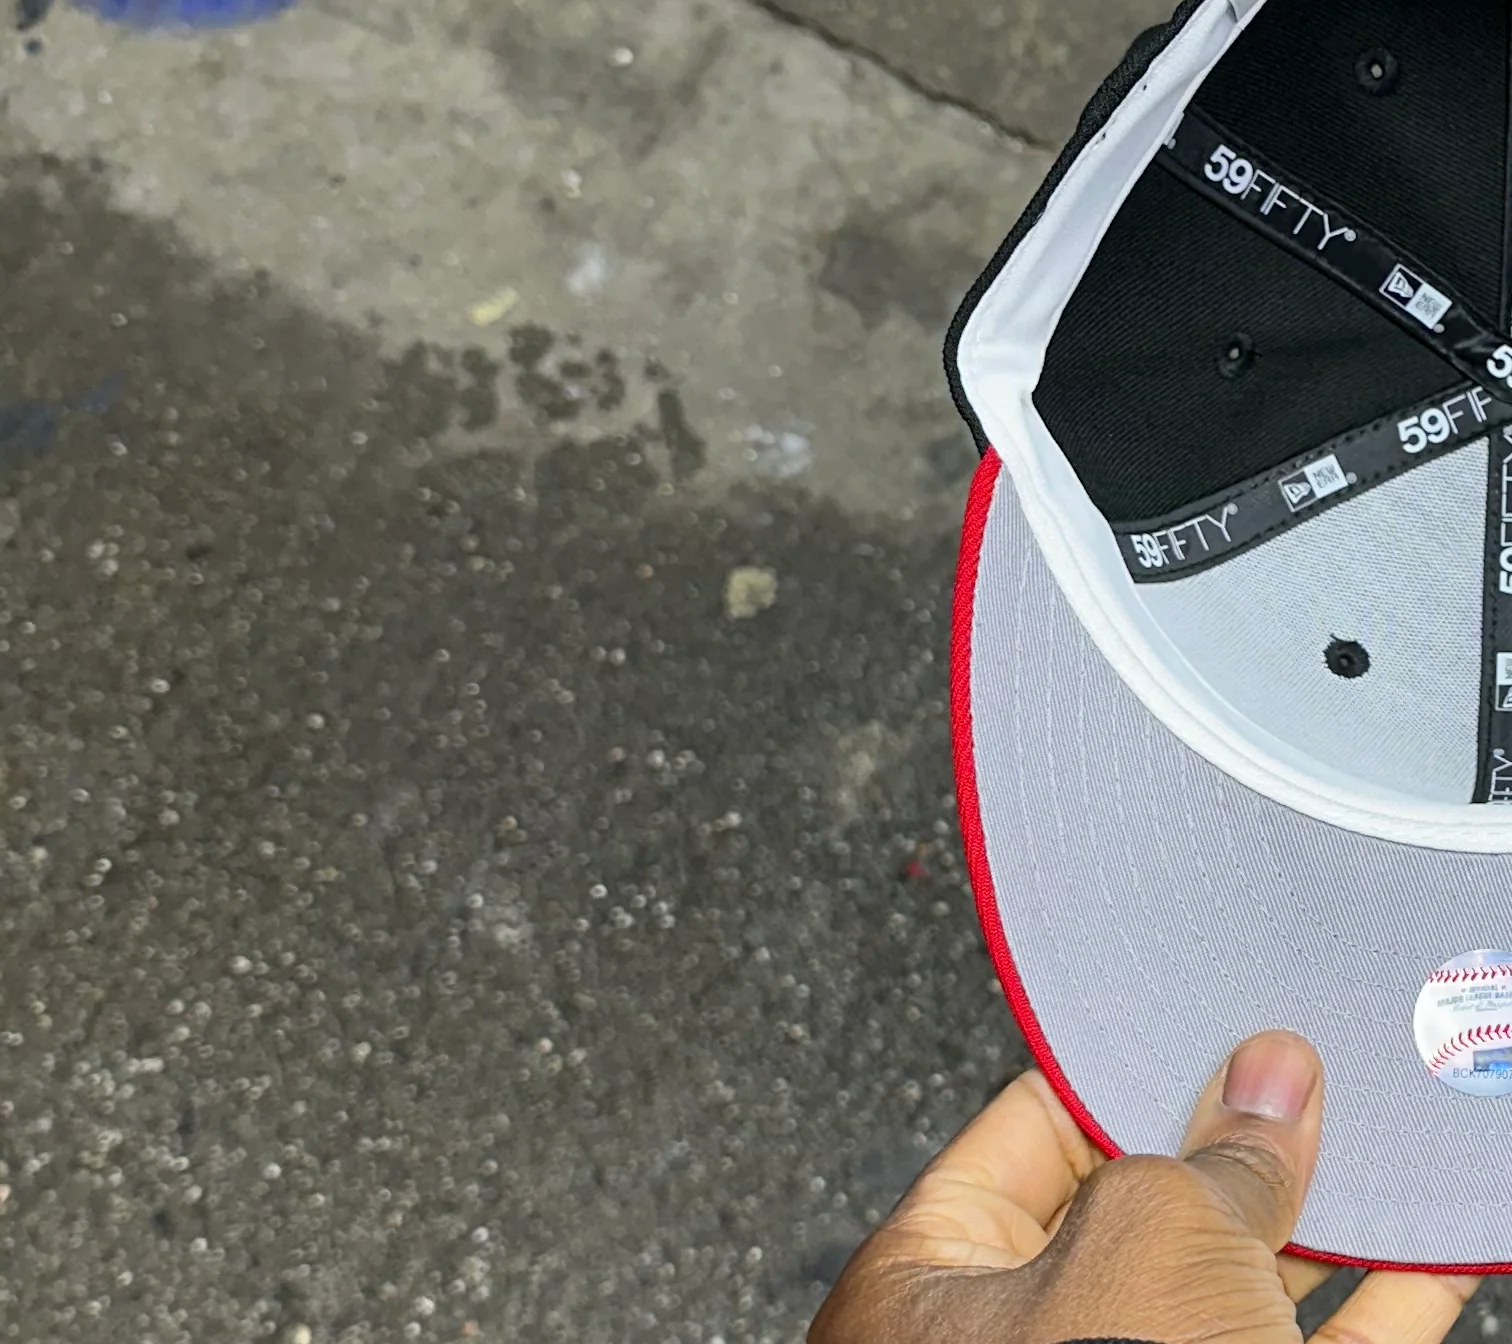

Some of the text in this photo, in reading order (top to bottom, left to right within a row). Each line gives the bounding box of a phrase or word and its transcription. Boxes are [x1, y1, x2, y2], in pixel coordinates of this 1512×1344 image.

[1204, 144, 1349, 250] 59FIFTY
[1397, 386, 1492, 453] 59FIF
[1130, 506, 1232, 568] 59FIFTY
